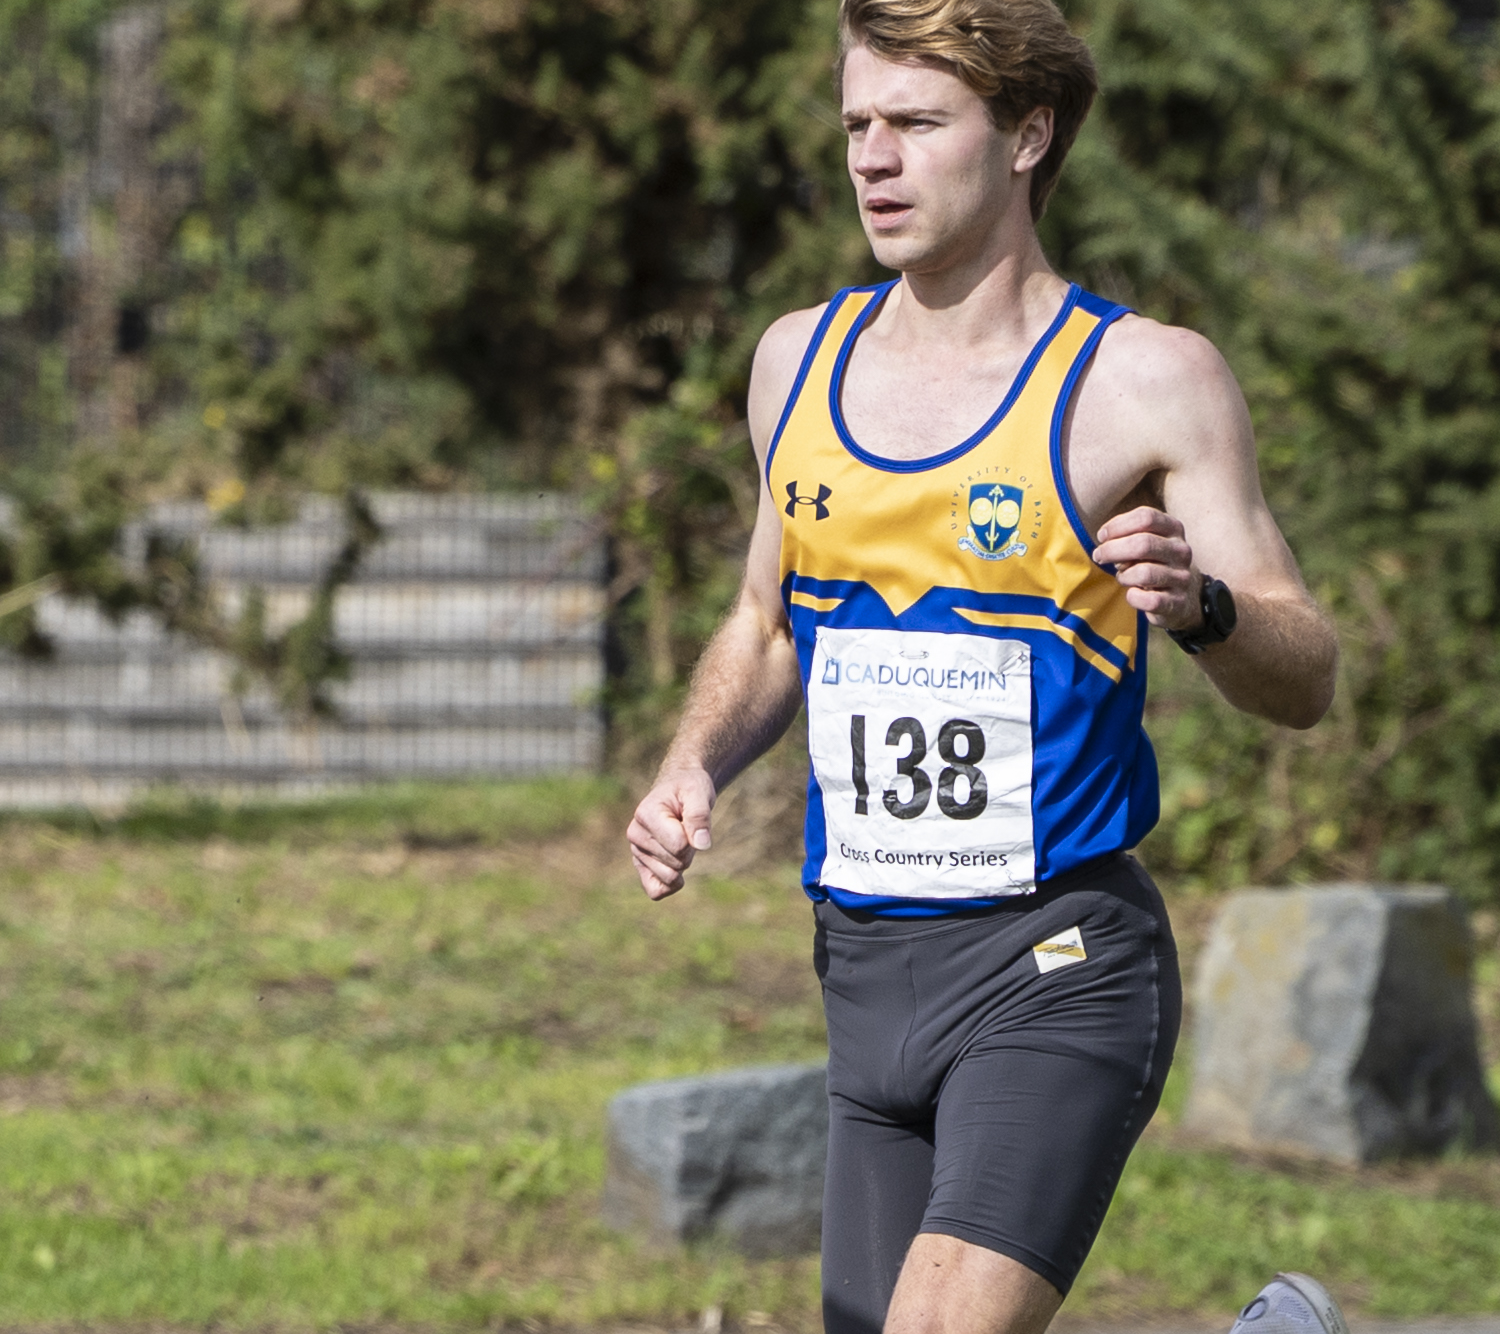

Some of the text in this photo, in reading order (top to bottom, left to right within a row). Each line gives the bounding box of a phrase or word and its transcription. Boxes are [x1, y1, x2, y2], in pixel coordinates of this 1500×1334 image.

[951, 466, 1041, 539] UNIVERSITY OF BATH
[850, 715, 988, 820] 138
[875, 849, 943, 870] Country
[949, 851, 1008, 866] Series
